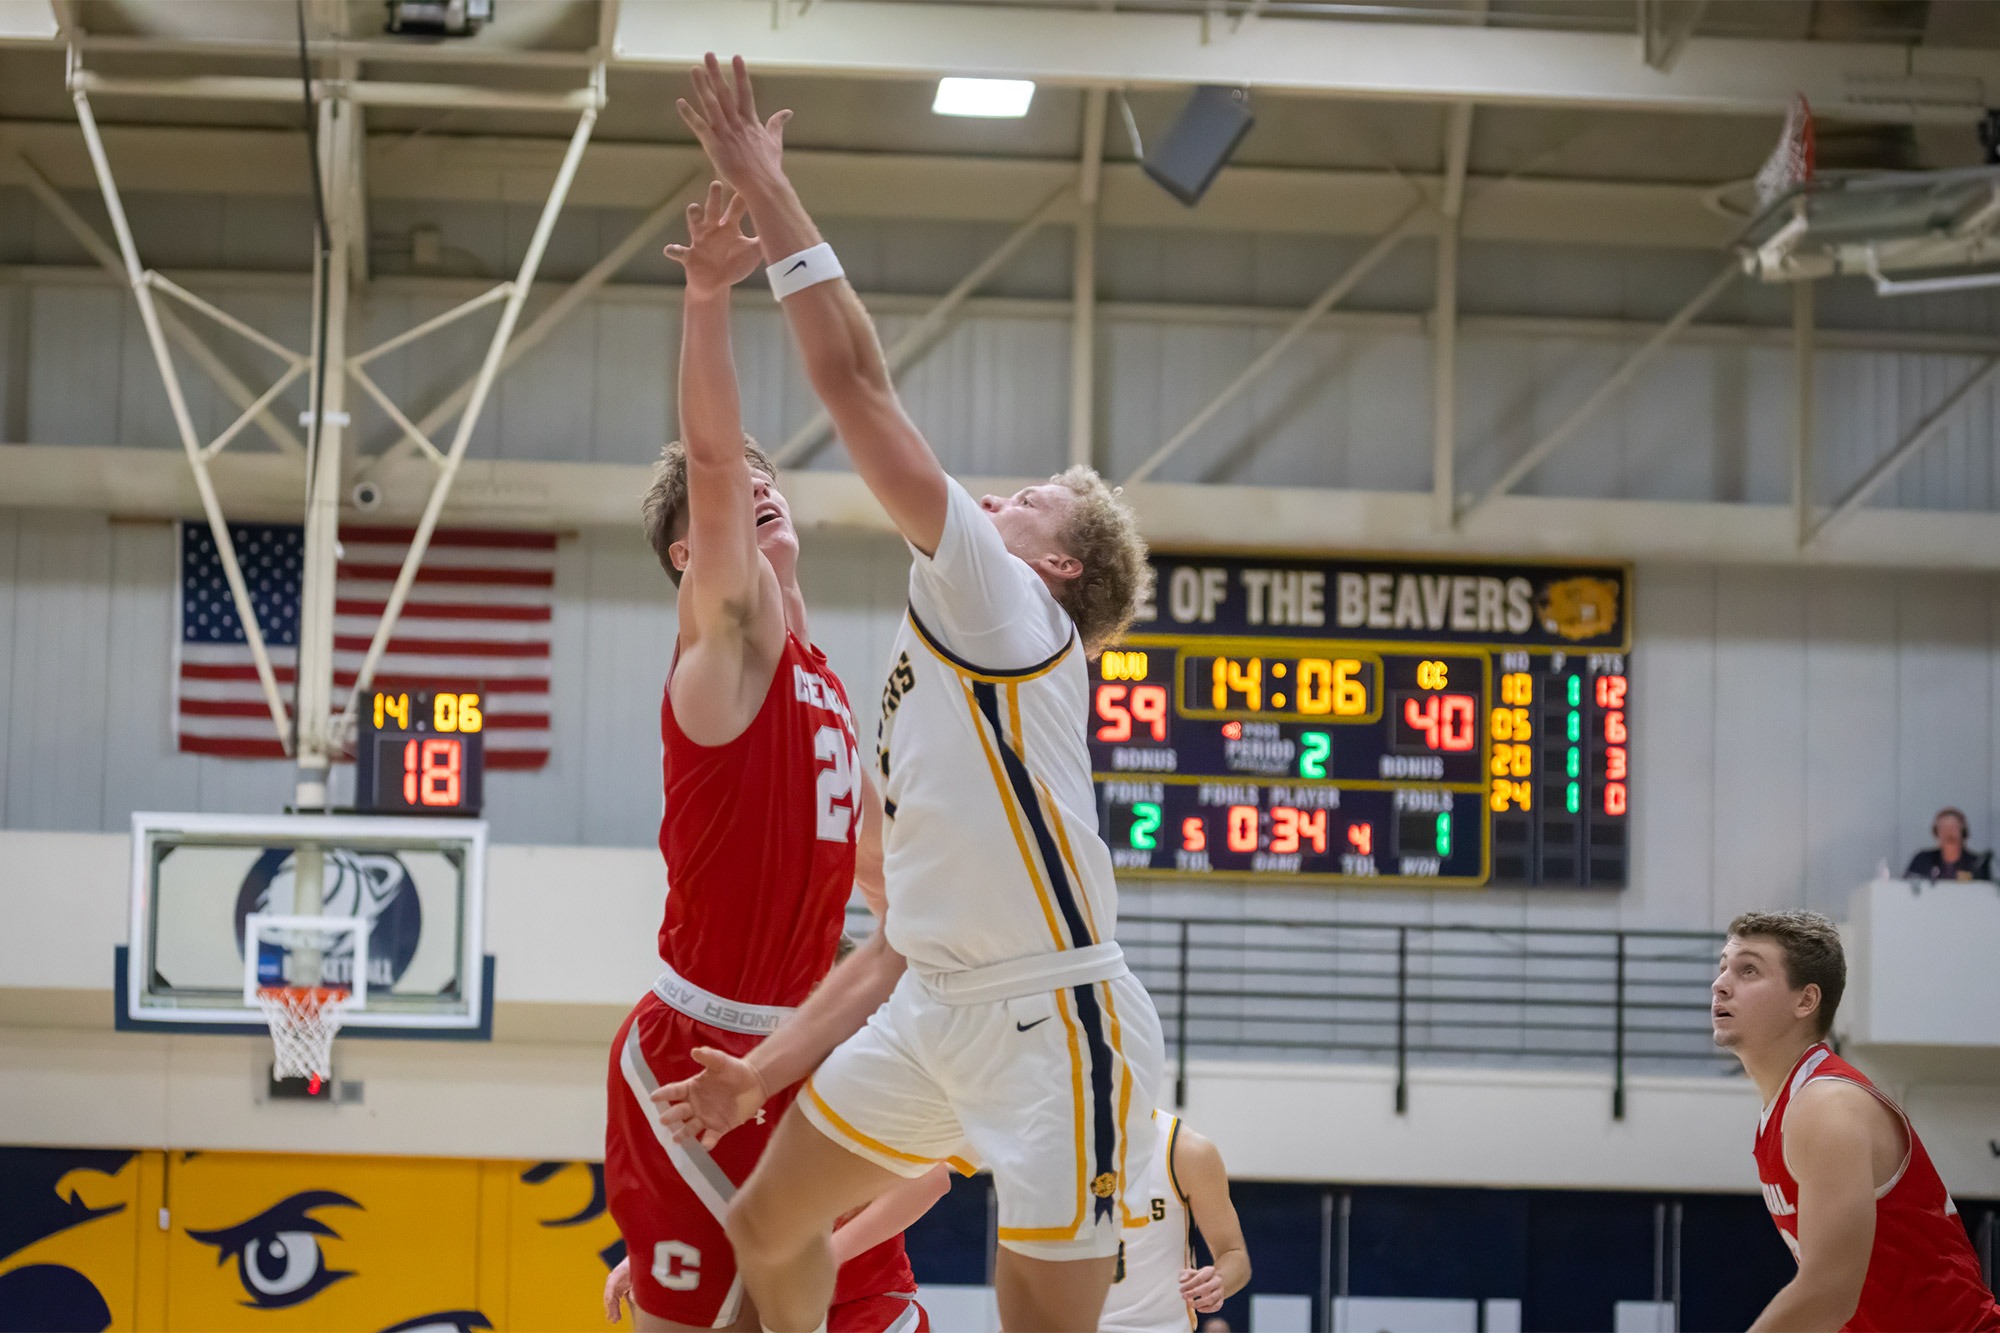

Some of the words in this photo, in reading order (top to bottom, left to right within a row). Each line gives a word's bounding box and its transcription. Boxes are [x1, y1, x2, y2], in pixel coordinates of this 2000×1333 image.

[1169, 566, 1228, 624] OF
[1240, 569, 1326, 627] THE
[1335, 572, 1534, 634] BEAVERS
[1212, 656, 1367, 716] 14:06
[1501, 672, 1533, 706] 10
[1567, 674, 1581, 707] 1
[1595, 675, 1628, 709] 12
[1096, 684, 1167, 742] 59
[1404, 694, 1475, 751] 40
[1491, 707, 1532, 741] 05
[1567, 710, 1580, 743] 1
[1604, 710, 1628, 744] 6
[403, 738, 461, 806] 18
[1112, 747, 1178, 771] BONUS
[1300, 731, 1331, 779] 2
[1379, 754, 1445, 779] BONUS
[1491, 743, 1532, 777] 20
[1566, 746, 1580, 778] 1
[1605, 746, 1628, 780] 3
[1104, 781, 1165, 803] FOULS
[1199, 783, 1260, 806] FOULS
[1269, 786, 1341, 809] PLAYER
[1393, 788, 1454, 811] FOULS
[1566, 781, 1580, 814] 1
[1603, 782, 1627, 816] 0
[1130, 802, 1162, 850] 2
[1182, 817, 1206, 852] 5
[1347, 822, 1372, 856] 4
[1436, 811, 1451, 857] 1
[1400, 856, 1441, 876] WON
[704, 1002, 780, 1028] UNDER
[652, 1240, 702, 1291] C
